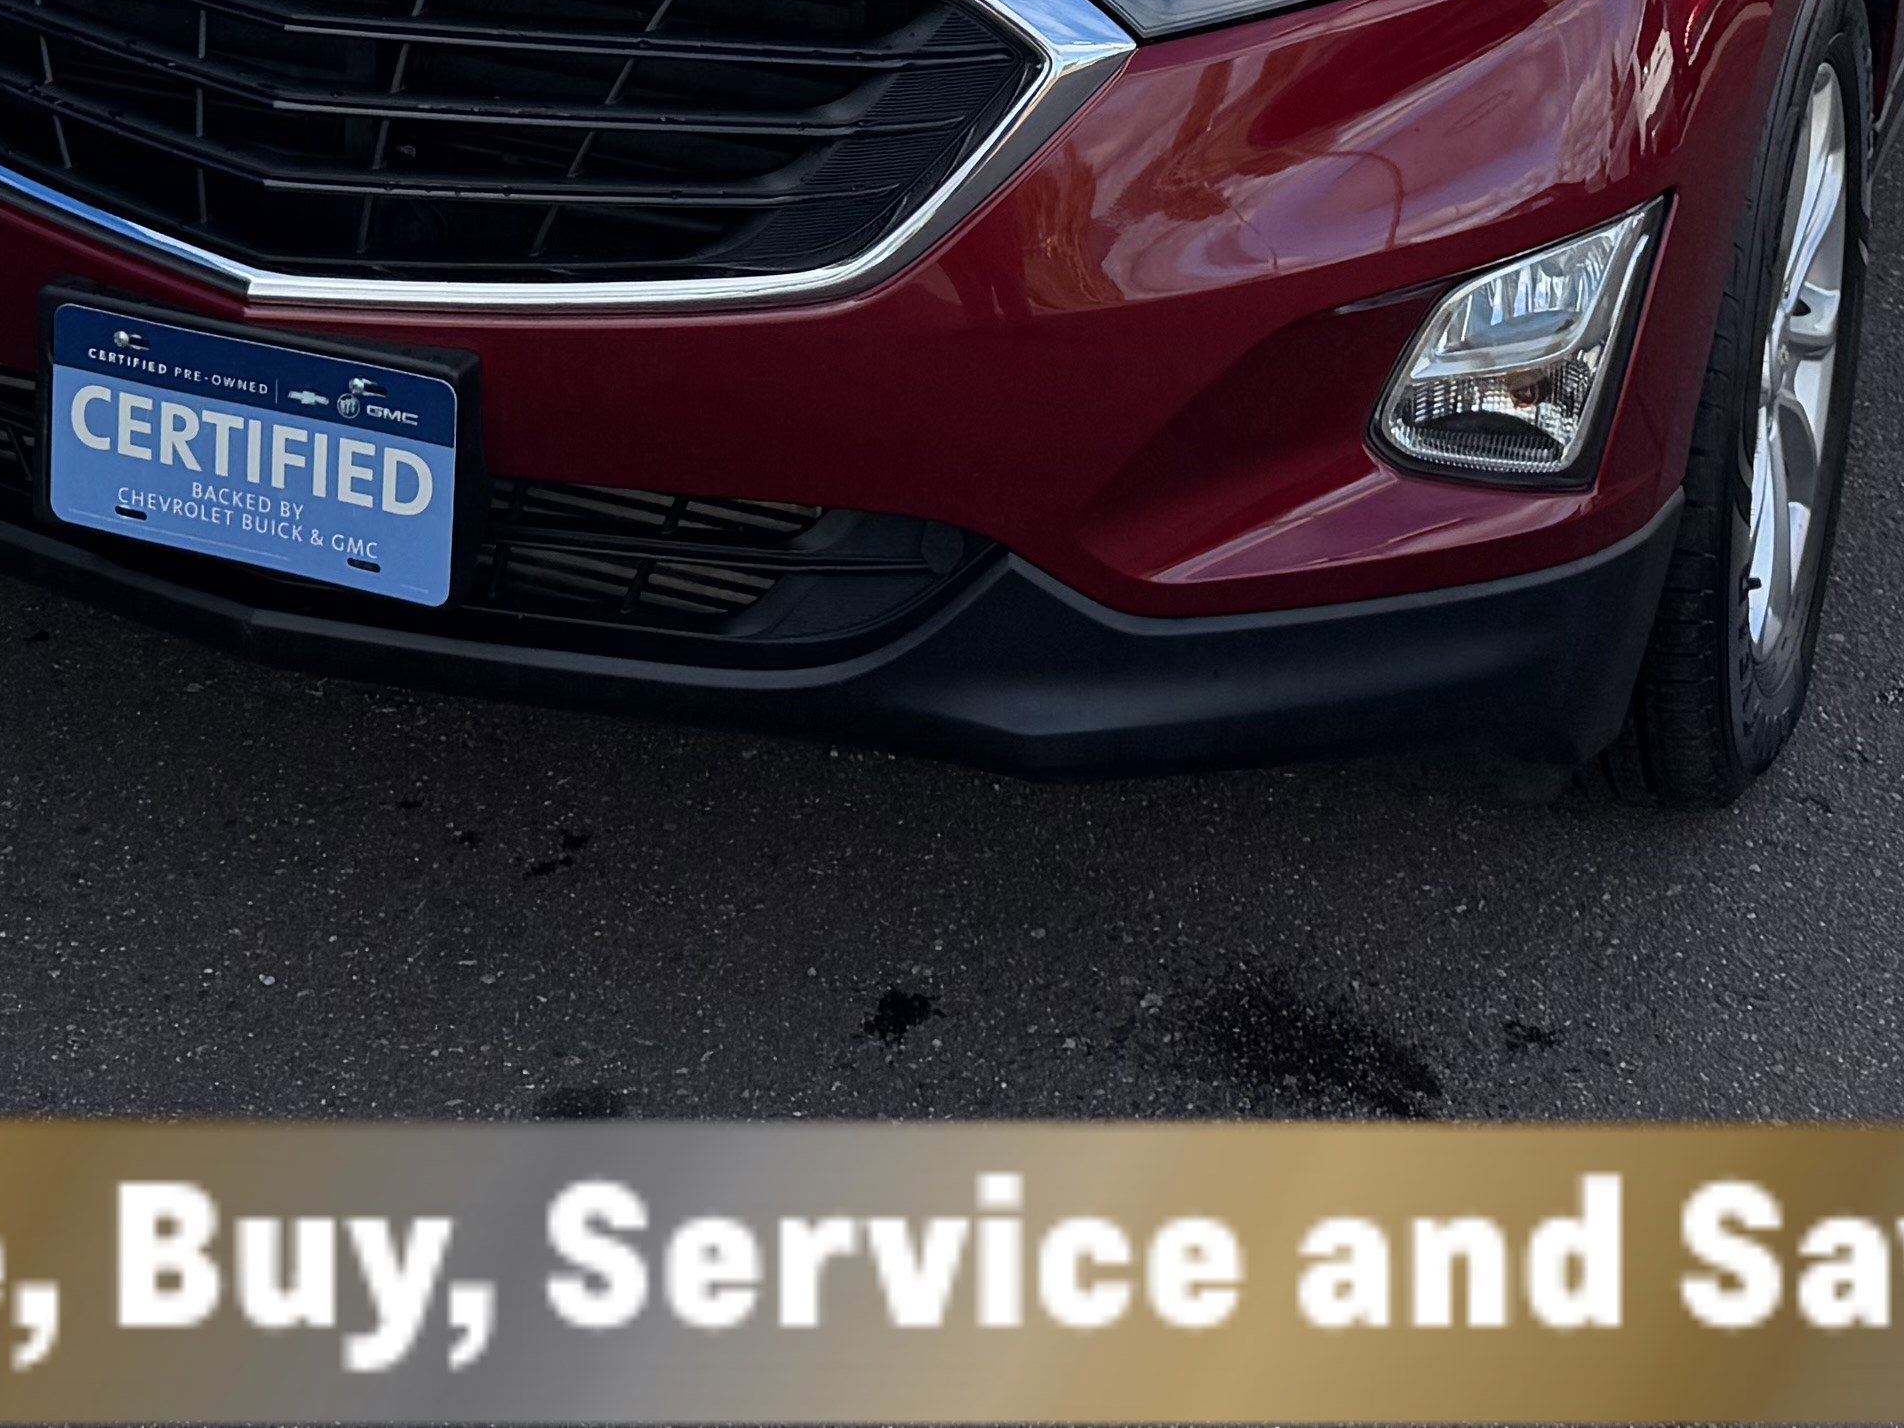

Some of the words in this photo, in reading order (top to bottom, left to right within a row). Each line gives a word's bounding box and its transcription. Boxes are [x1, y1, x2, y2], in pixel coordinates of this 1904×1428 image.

[87, 347, 168, 375] CERTIFIED
[174, 366, 268, 395] PRE-OWNED
[366, 404, 419, 426] GMC
[70, 384, 434, 517] CERTIFIED
[117, 486, 234, 526] CHEVROLET
[242, 513, 303, 543] BUICK
[310, 528, 324, 547] &
[332, 534, 378, 559] GMC
[192, 481, 271, 513] BACKED
[280, 500, 304, 521] BY
